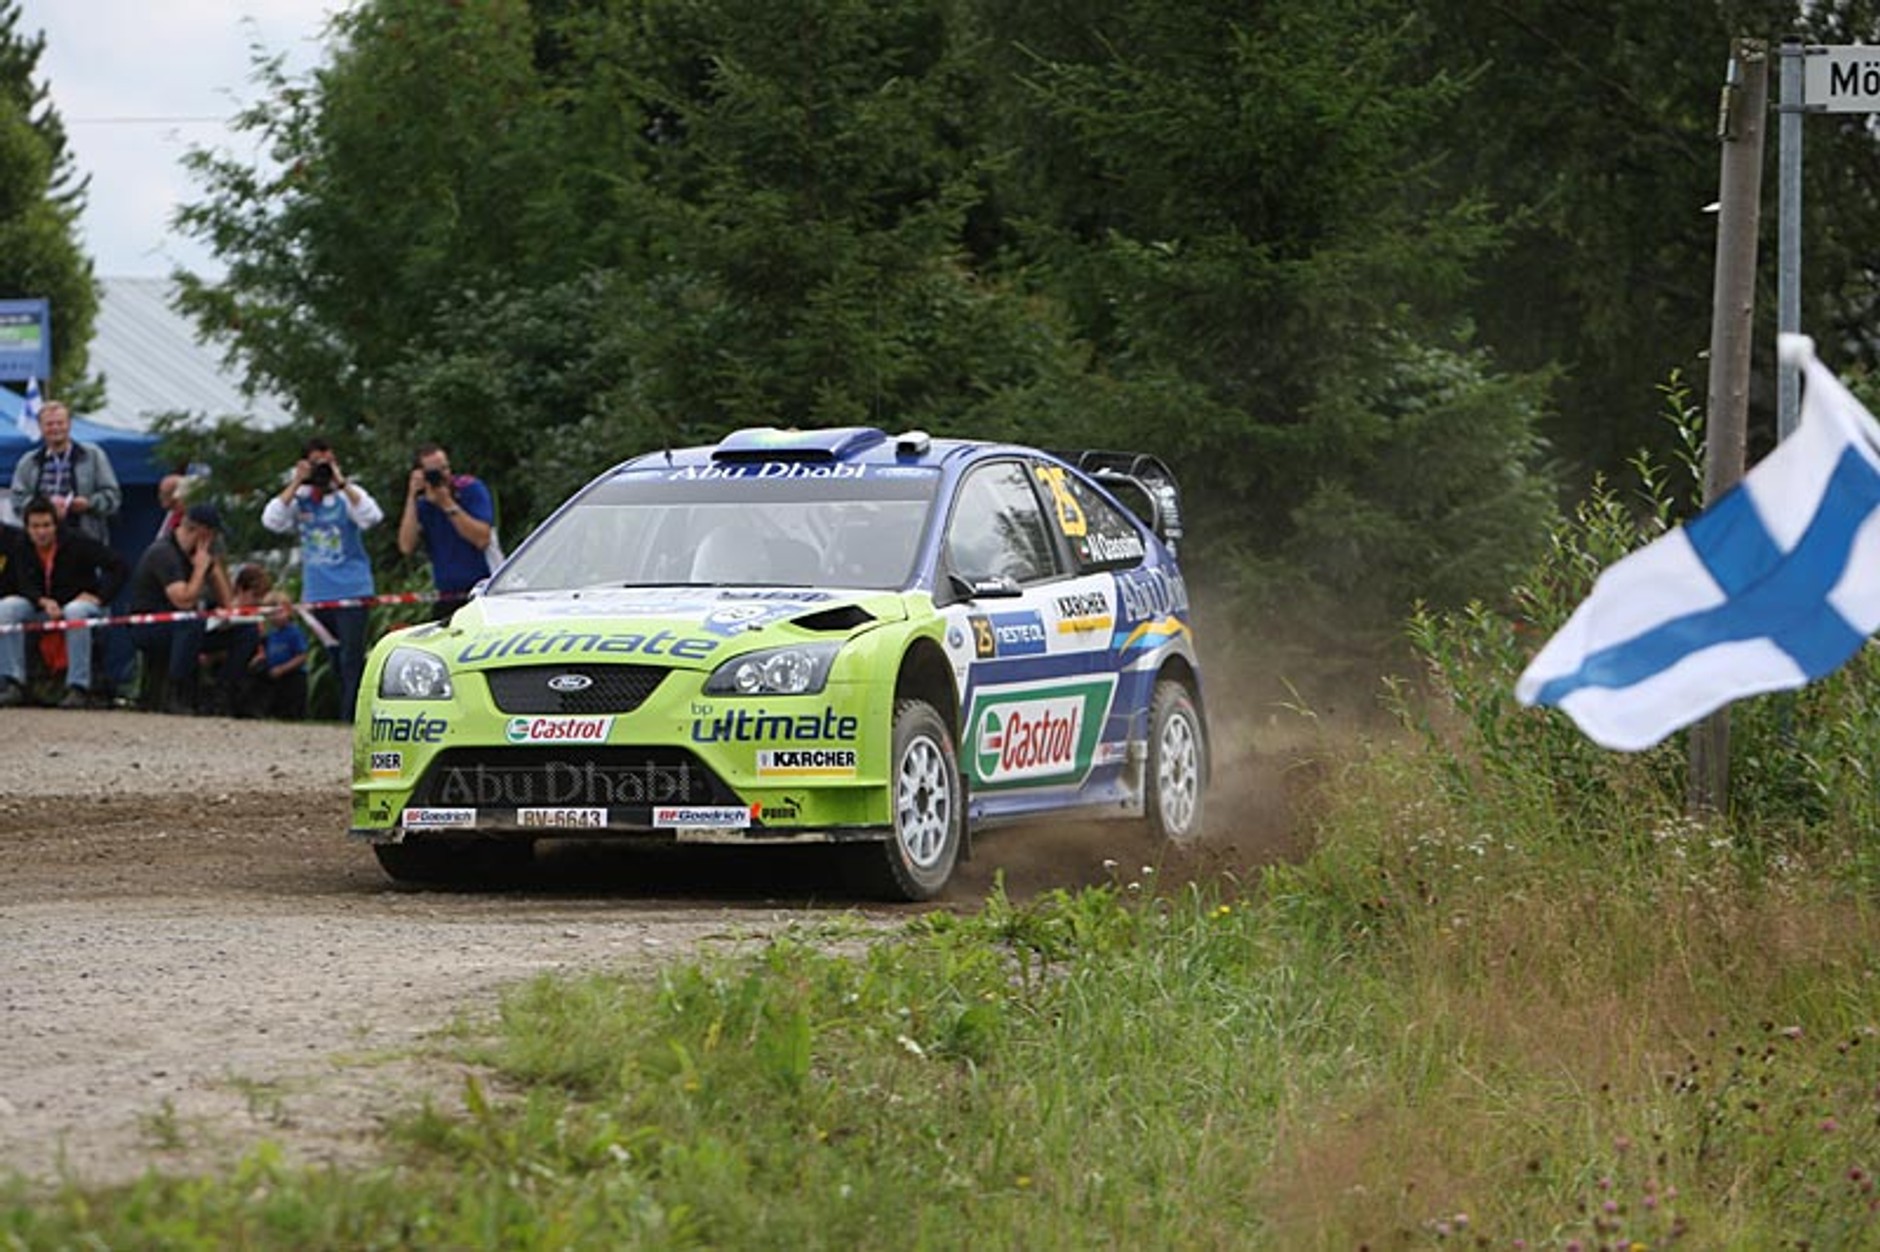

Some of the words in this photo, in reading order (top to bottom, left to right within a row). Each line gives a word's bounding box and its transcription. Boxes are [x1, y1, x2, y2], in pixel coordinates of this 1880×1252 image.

[1831, 61, 1880, 96] Mö
[669, 463, 748, 480] Abu
[756, 462, 867, 479] Dhabi
[1035, 467, 1087, 536] 25
[457, 630, 718, 664] ultimate
[973, 619, 994, 653] 25
[691, 702, 713, 716] bp
[691, 706, 858, 742] ultimate
[530, 718, 604, 740] Castrol
[1002, 706, 1077, 772] Castrol
[442, 762, 533, 803] Abu
[545, 760, 690, 803] Dhabi
